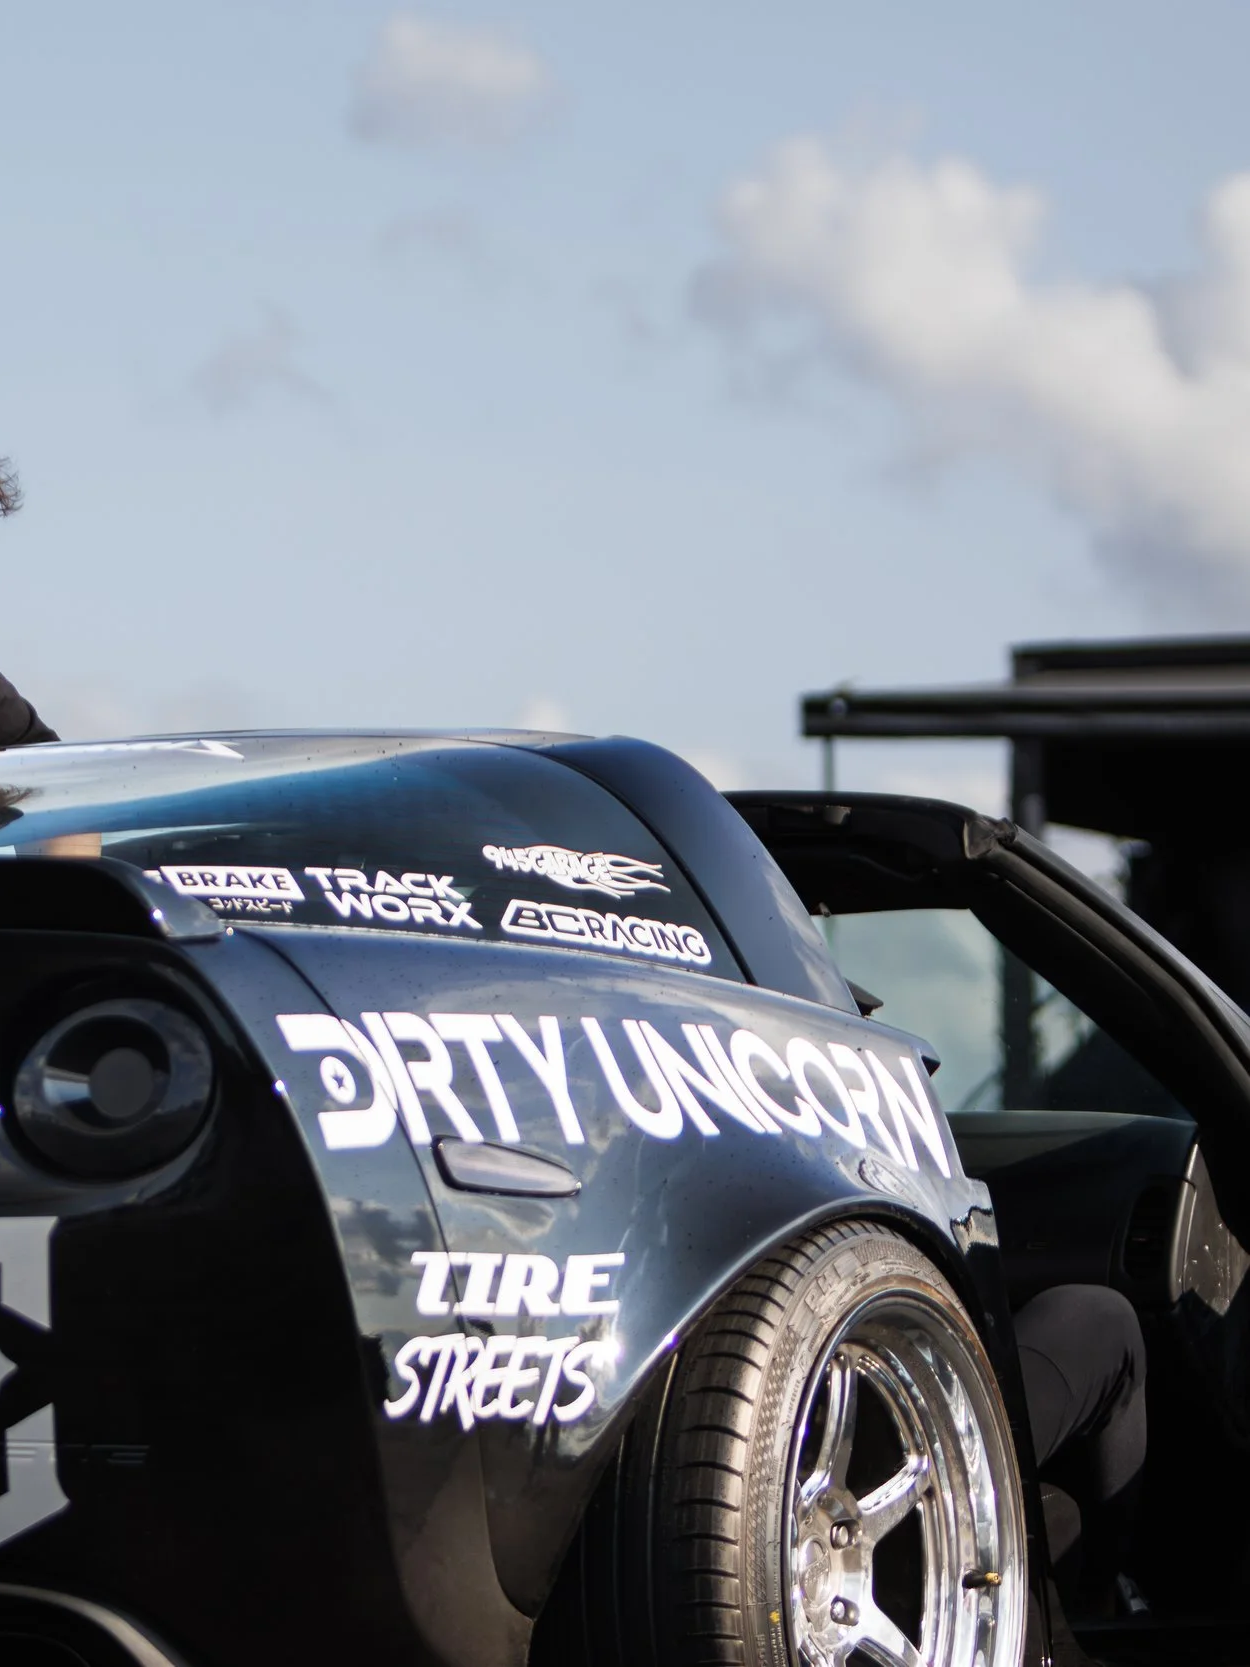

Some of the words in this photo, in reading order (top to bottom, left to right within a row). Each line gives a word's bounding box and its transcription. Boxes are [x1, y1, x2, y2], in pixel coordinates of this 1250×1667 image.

[175, 869, 293, 892] BRAKE
[303, 866, 466, 900] TRACK
[325, 892, 484, 930] WORX
[275, 1011, 586, 1151] DIRTY
[581, 1015, 952, 1179] UNICORN
[410, 1251, 626, 1317] TIRE
[383, 1331, 610, 1431] STREETS
